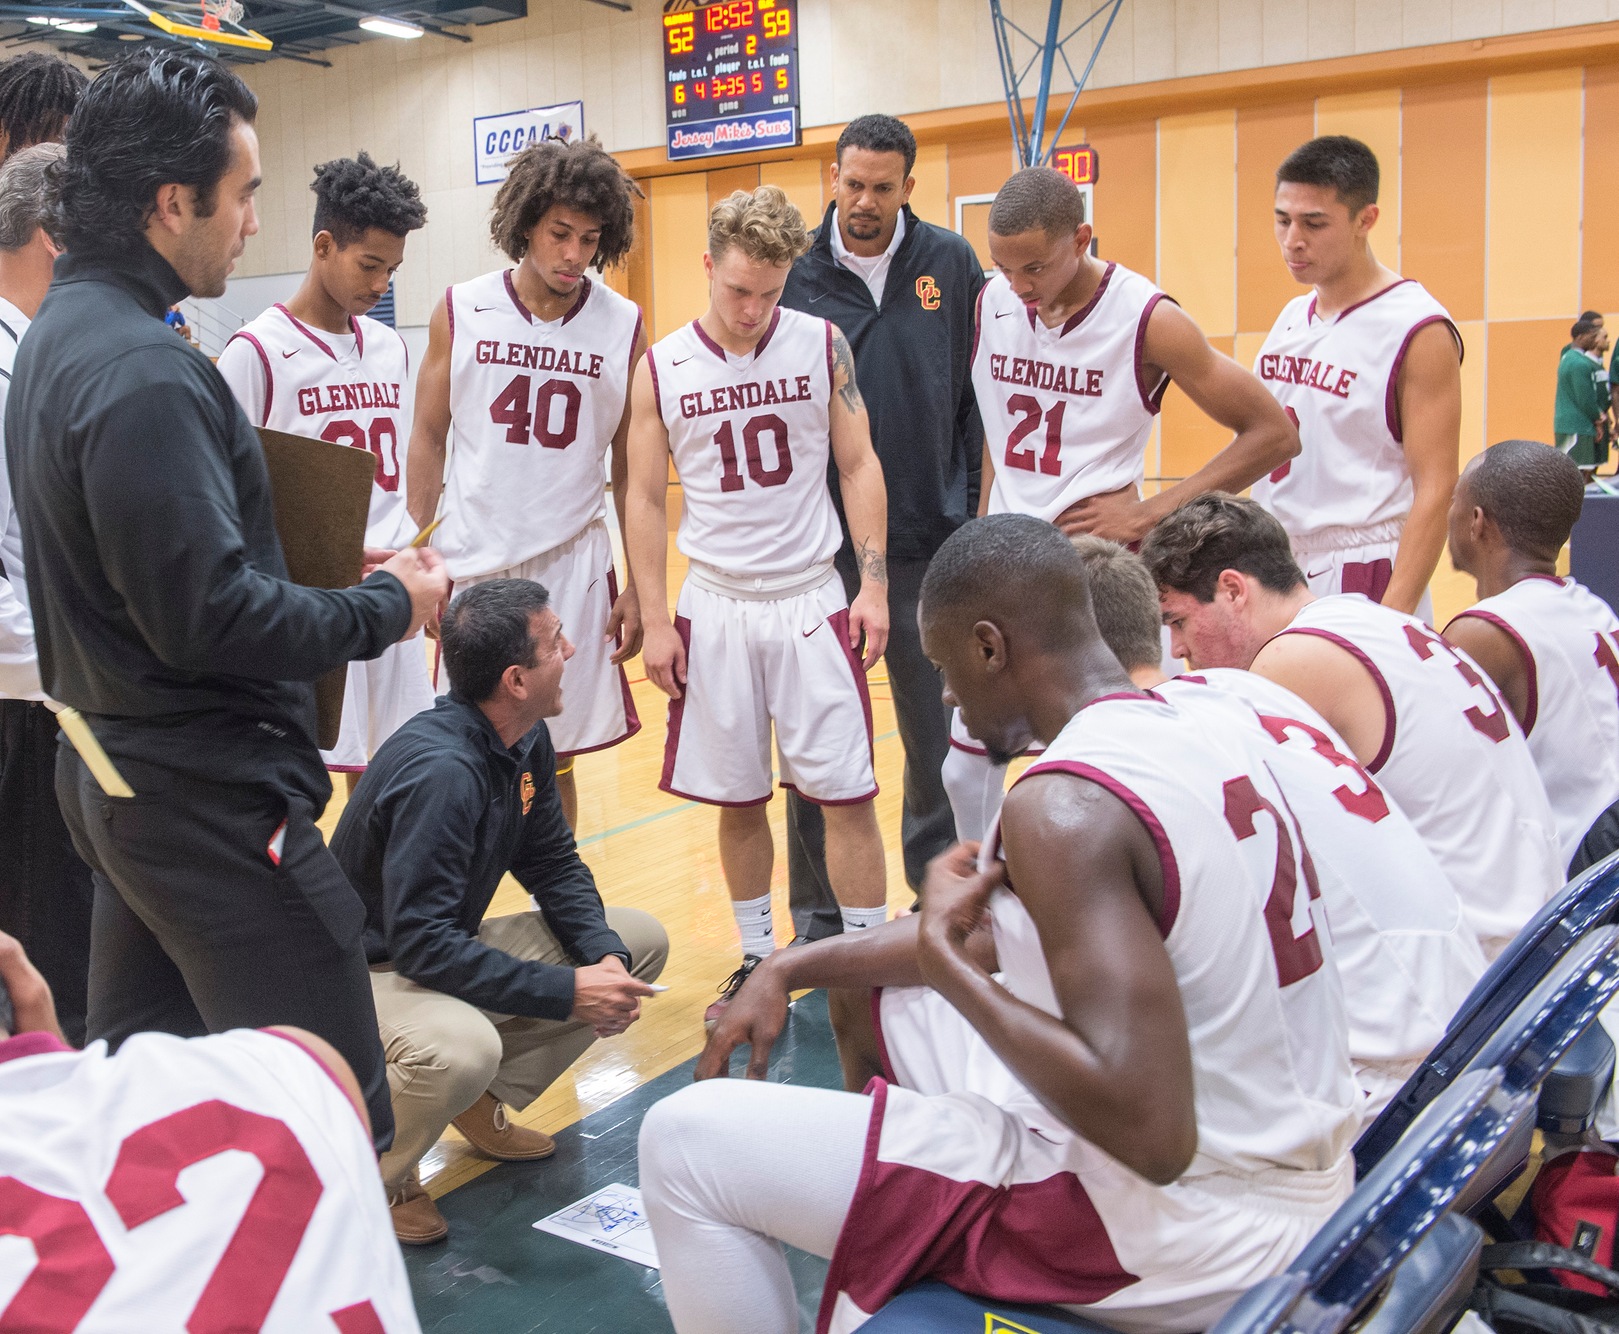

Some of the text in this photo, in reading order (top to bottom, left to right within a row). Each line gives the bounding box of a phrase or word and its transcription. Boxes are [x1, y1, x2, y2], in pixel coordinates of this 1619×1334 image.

[706, 1, 753, 31] 12:52
[763, 9, 790, 38] 59
[669, 26, 694, 54] 52
[715, 35, 757, 58] period 2
[669, 70, 687, 82] fouls
[715, 61, 740, 75] player
[770, 53, 789, 66] fouls
[674, 84, 686, 104] 6
[695, 82, 706, 99] 4
[751, 73, 763, 93] 5
[776, 68, 788, 89] 5
[672, 94, 789, 118] won game won
[671, 130, 713, 149] Jersey
[1057, 151, 1092, 183] 30
[476, 340, 604, 379] GLENDALE
[989, 353, 1104, 397] GLENDALE
[489, 374, 582, 450] 40
[680, 375, 812, 419] GLENDALE
[1004, 393, 1067, 477] 21
[713, 413, 793, 493] 10
